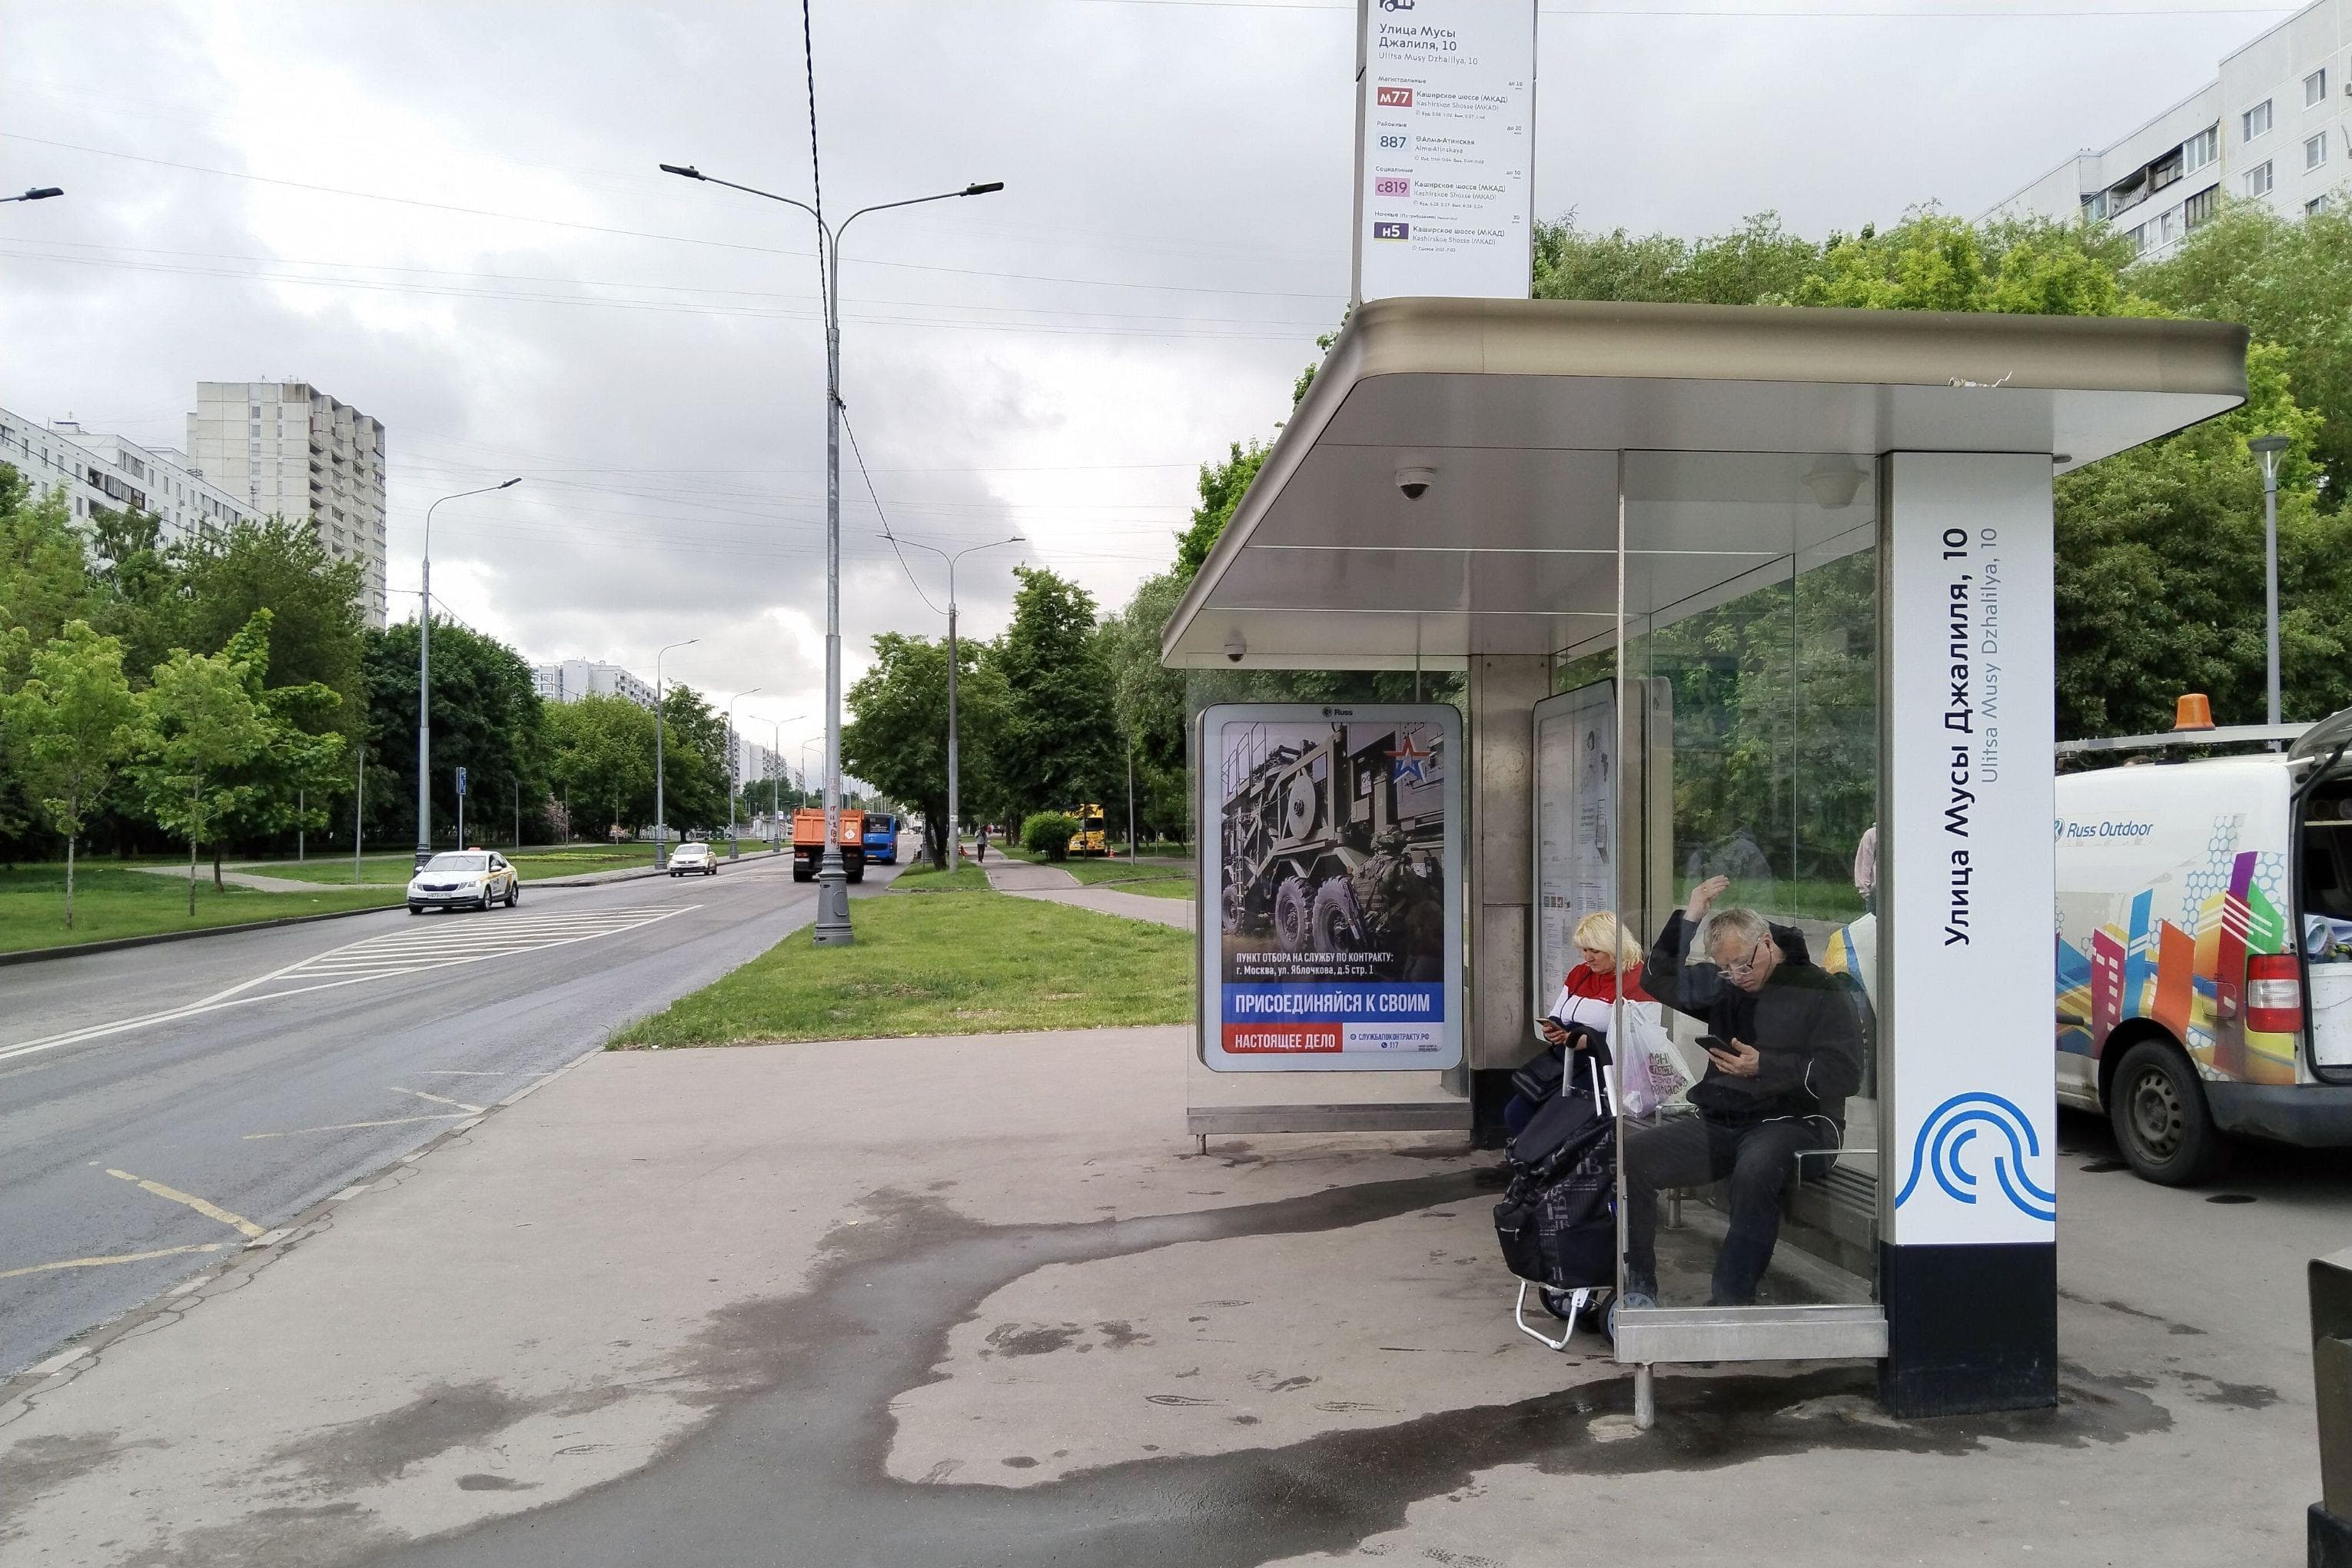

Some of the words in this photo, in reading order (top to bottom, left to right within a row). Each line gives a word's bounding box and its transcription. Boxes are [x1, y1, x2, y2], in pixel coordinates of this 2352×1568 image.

[1380, 24, 1417, 37] Улица
[1420, 26, 1456, 39] Мусы
[1379, 37, 1438, 51] Джалиля,
[1442, 41, 1457, 51] 10
[1379, 52, 1402, 61] Ulitsa
[1404, 54, 1426, 63] Musy
[1428, 55, 1467, 65] Dzhalilya,
[1380, 91, 1410, 104] м77
[1417, 91, 1456, 99] Каширское
[1380, 135, 1407, 148] 887
[1422, 137, 1475, 145] Алма-Атинская
[1377, 181, 1407, 193] с819
[1414, 181, 1453, 189] Каширское
[1478, 184, 1506, 193] (МКАД)
[1383, 225, 1400, 238] н5
[1414, 225, 1453, 234] Каширское
[1943, 528, 1968, 561] 10
[1981, 527, 1997, 550] 10
[1980, 557, 2002, 654] Dzhalilya,
[1944, 574, 1973, 734] Джалиля,
[1981, 663, 2002, 719] Musy
[1981, 726, 1998, 783] Ulitsa
[1945, 745, 1975, 837] Мусы
[2067, 822, 2097, 838] Russ
[2099, 820, 2153, 836] Outdoor
[1945, 849, 1974, 946] Улица
[1236, 952, 1261, 962] ПУНКТ
[1262, 952, 1291, 962] ОТБОРА
[1293, 952, 1303, 962] НА
[1304, 952, 1335, 962] СЛУЖБУ
[1337, 952, 1347, 962] ПО
[1349, 952, 1394, 962] КОНТРАКТУ:
[1244, 965, 1277, 976] Москва,
[1277, 967, 1289, 976] ул.
[1291, 965, 1337, 976] Яблочкова,
[1351, 967, 1367, 976] стр.
[1370, 965, 1374, 975] 1
[1235, 990, 1362, 1014] ПРИСОЕДИНЯЙСЯ
[1366, 994, 1375, 1012] К
[1380, 993, 1430, 1012] СВОИМ
[1235, 1034, 1303, 1050] НАСТОЯЩЕЕ
[1305, 1033, 1336, 1049] ДЕЛО
